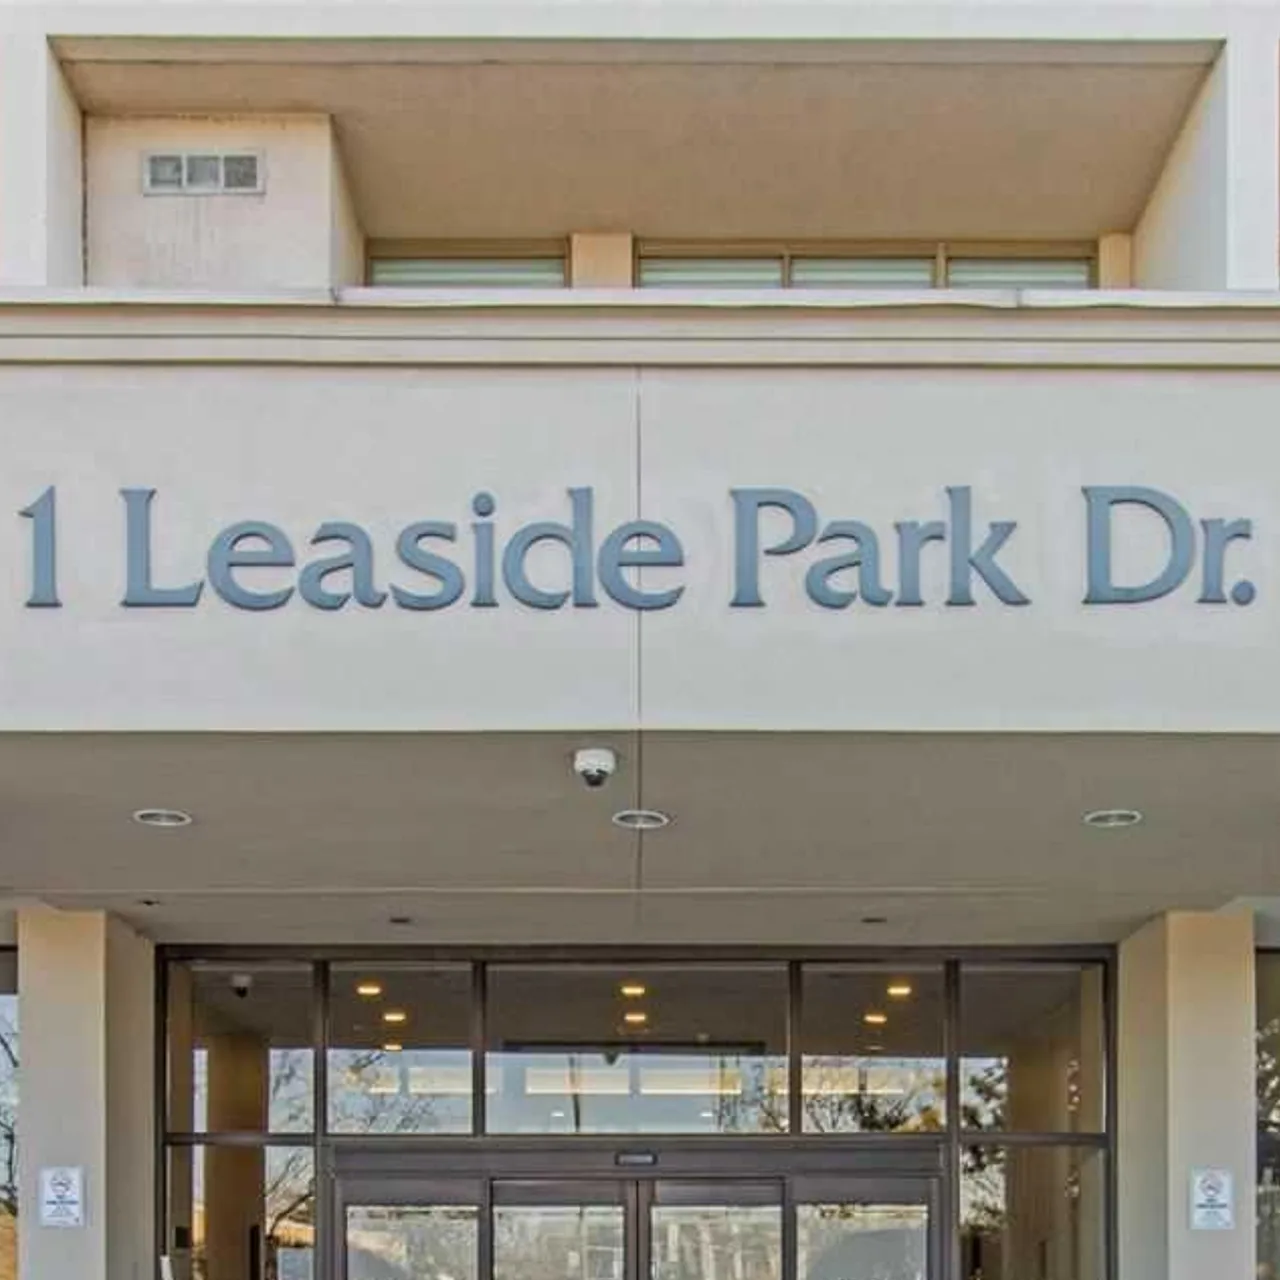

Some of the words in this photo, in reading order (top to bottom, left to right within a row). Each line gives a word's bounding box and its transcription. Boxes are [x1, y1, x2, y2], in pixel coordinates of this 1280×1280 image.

[18, 485, 62, 609] 1
[121, 485, 686, 611] Leaside
[728, 485, 1031, 609] Park
[1082, 485, 1257, 607] Dr.
